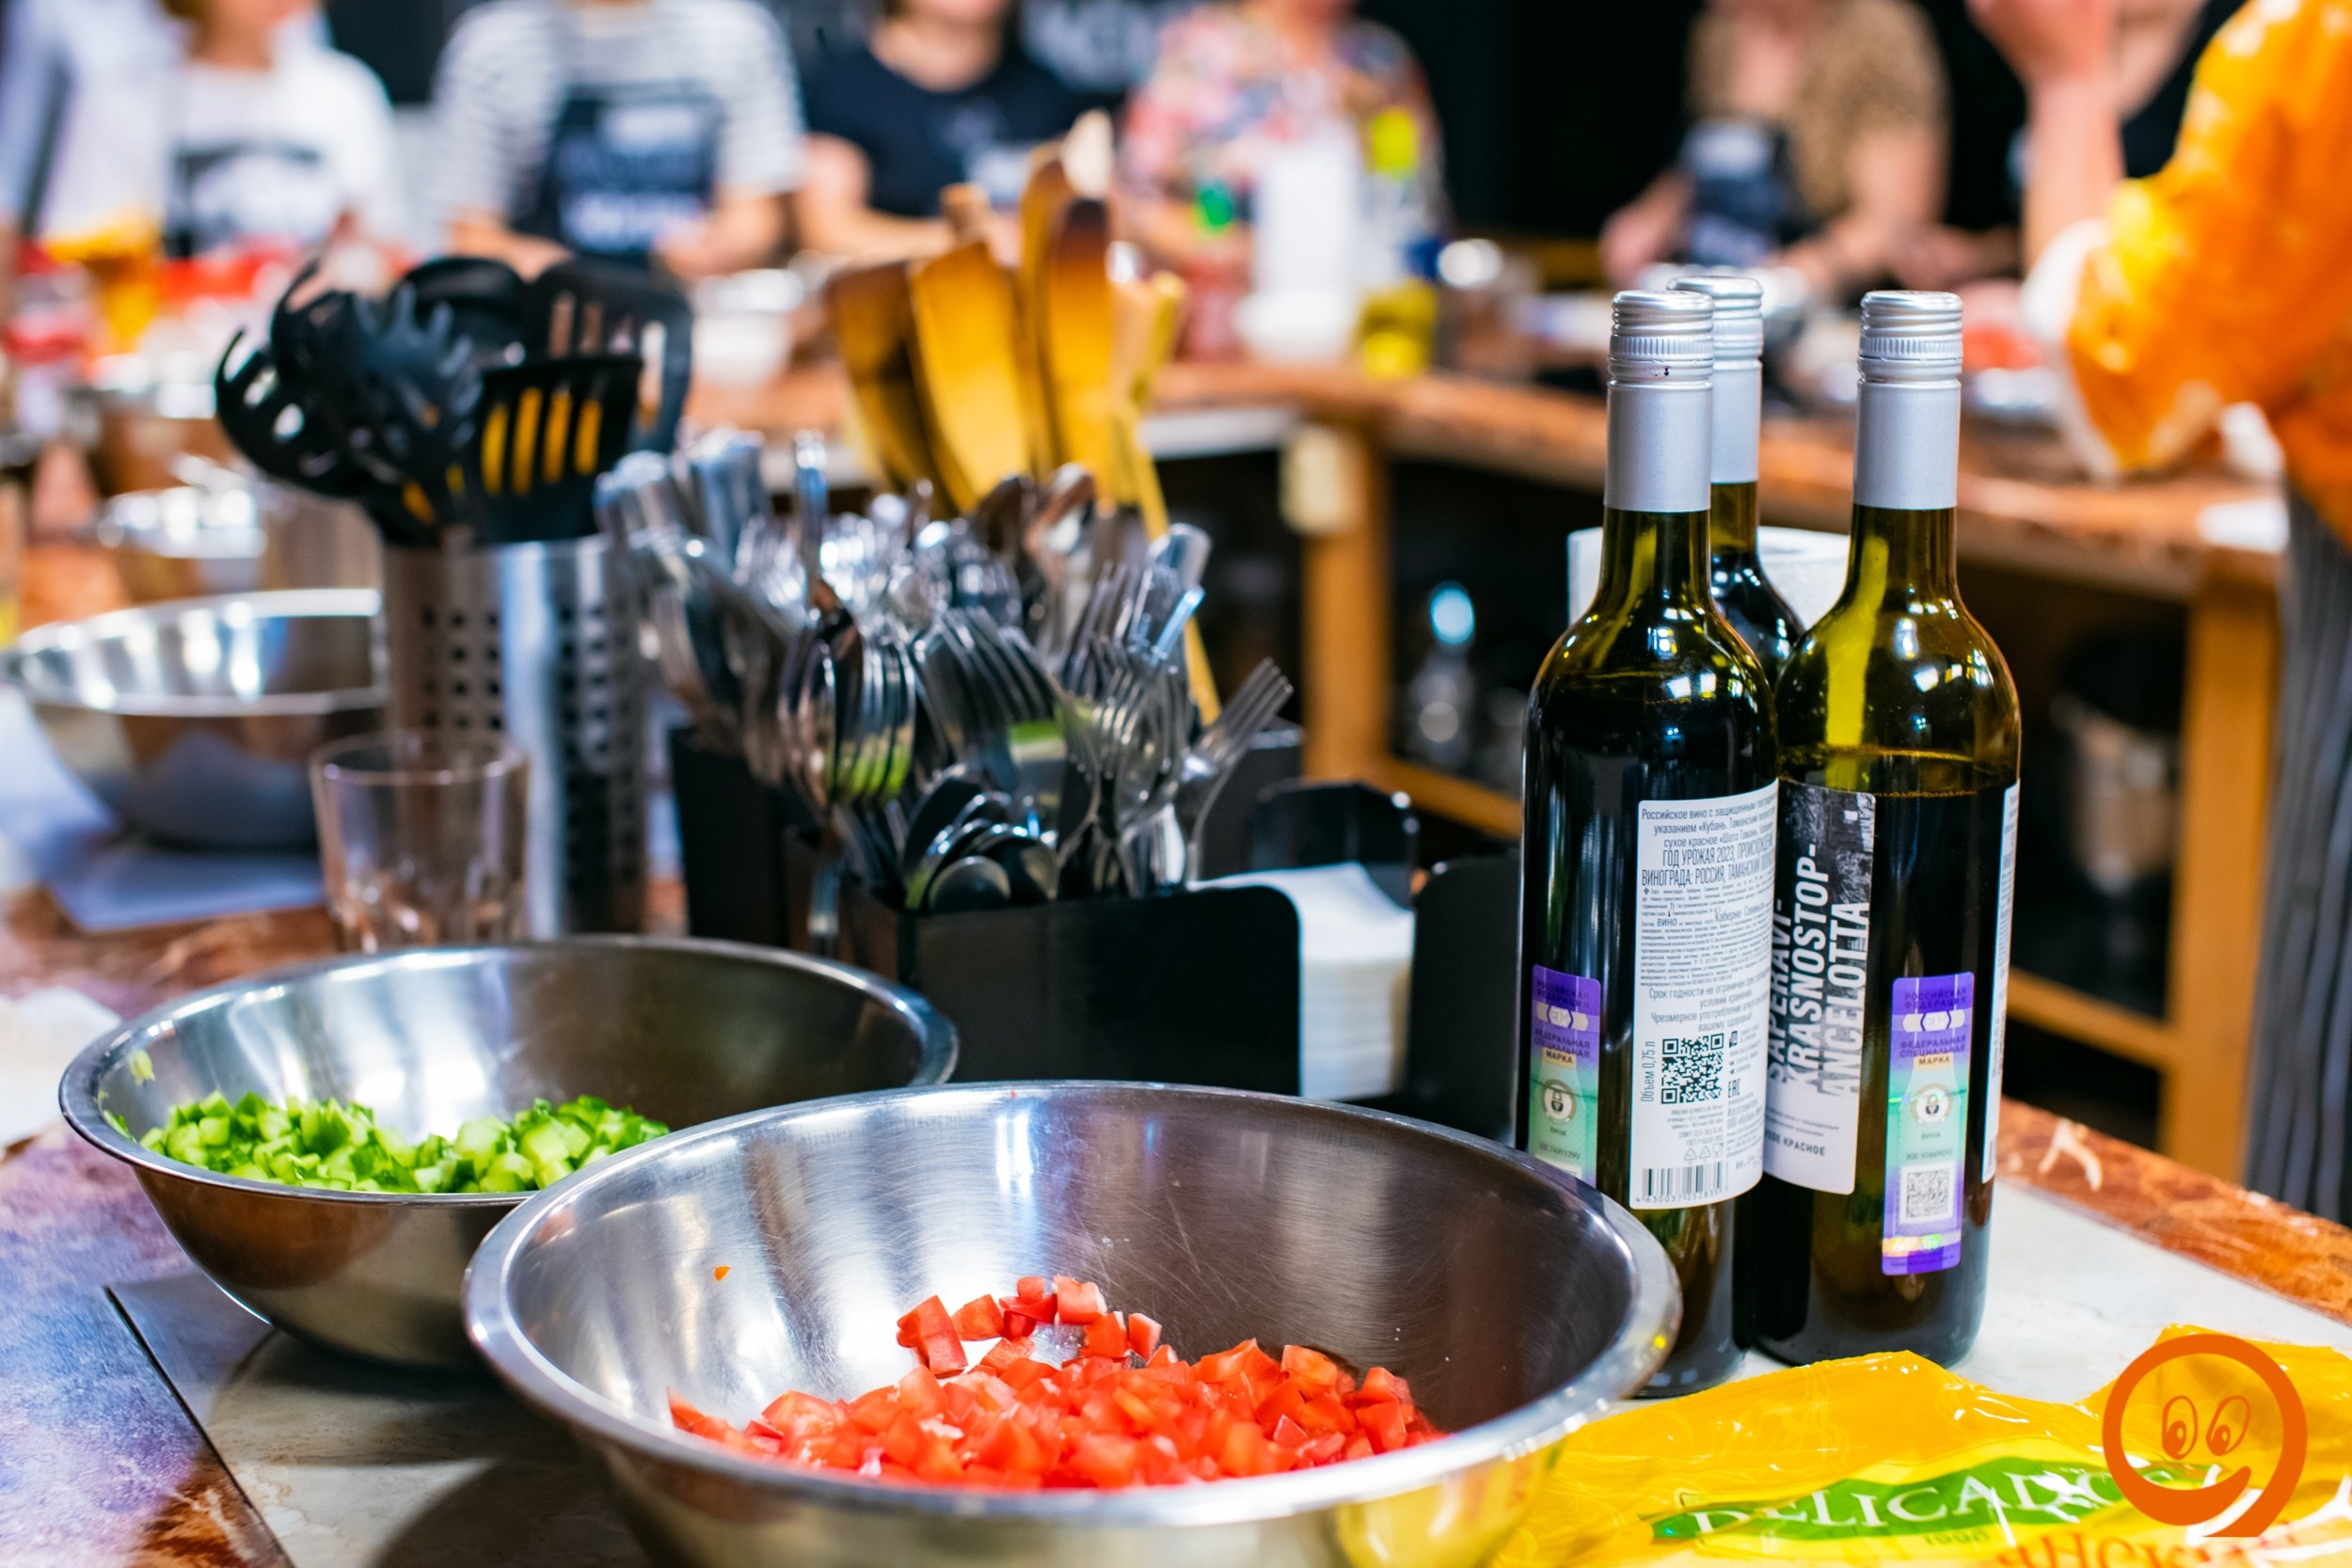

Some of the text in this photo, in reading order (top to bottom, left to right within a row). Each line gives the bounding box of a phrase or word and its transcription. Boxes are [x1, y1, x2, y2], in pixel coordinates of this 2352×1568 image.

[1642, 808, 1688, 820] Российское
[1690, 808, 1708, 819] вино
[1654, 824, 1697, 836] указанием
[1663, 837, 1687, 849] сухое
[1688, 835, 1718, 848] красное
[1662, 849, 1680, 868] ГОД
[1681, 847, 1715, 866] УРОЖАЯ
[1642, 869, 1692, 888] ВИНОГРАДА:
[1648, 988, 1667, 1000] Срок
[1669, 987, 1705, 999] годности
[1821, 902, 1870, 1097] ANCELOTTA
[1650, 1011, 1698, 1024] Чрезмерное
[1900, 1036, 1966, 1049] ФЕДЕРАЛЬНАЯ
[1546, 1050, 1574, 1064] МАРКА
[1899, 1043, 1966, 1059] СПЕЦИАЛЬНАЯ
[1641, 1049, 1657, 1069] 0,75
[1918, 1055, 1950, 1066] МАРКА
[1640, 1070, 1655, 1102] Объем
[1783, 1135, 1826, 1157] КРАСНОЕ
